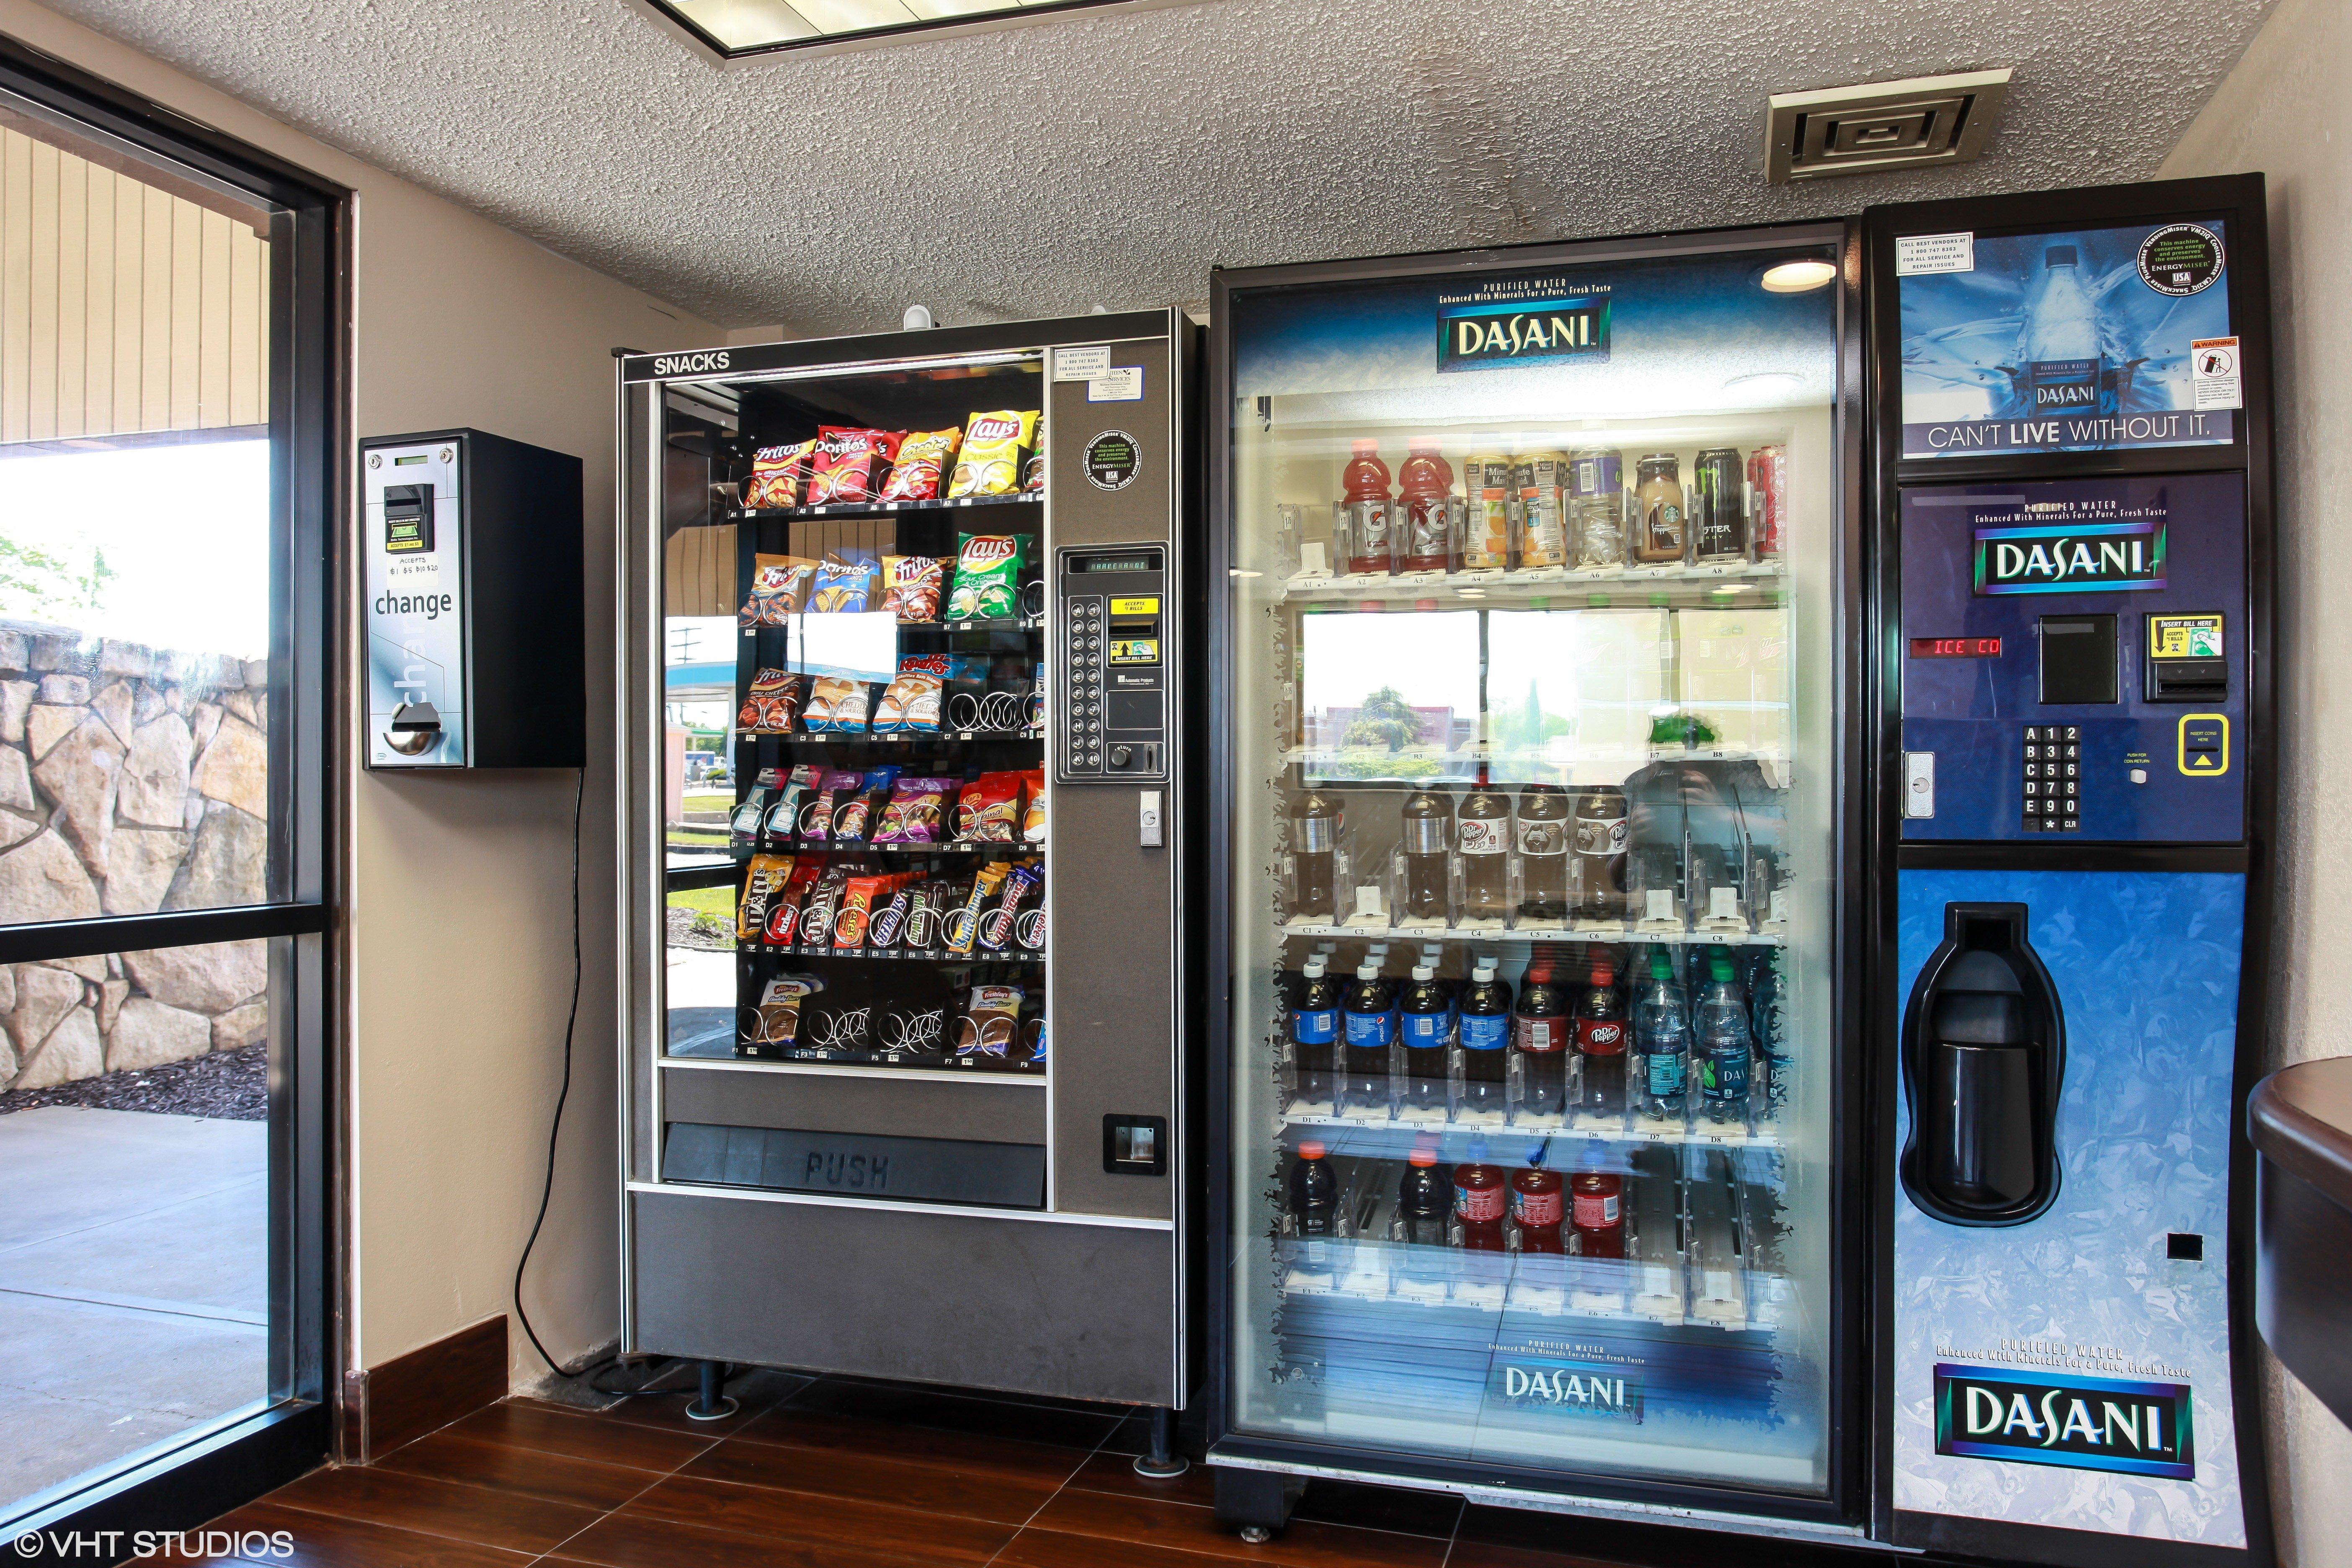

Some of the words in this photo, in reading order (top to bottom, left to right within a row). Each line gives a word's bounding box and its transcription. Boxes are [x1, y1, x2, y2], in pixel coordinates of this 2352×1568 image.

[2173, 273, 2190, 282] USA
[1484, 281, 1528, 292] PURIFIED
[1535, 279, 1566, 289] WATER
[1494, 291, 1524, 299] Minerals
[1570, 285, 1589, 294] Fresh
[1459, 314, 1589, 356] DASANI
[655, 352, 730, 375] SNACKS
[2037, 386, 2094, 405] DASANI
[967, 420, 1018, 441] Lay's
[1928, 425, 2001, 448] CAN'T
[2011, 422, 2059, 444] LIVE
[2068, 416, 2179, 441] WITHOUT
[2190, 415, 2210, 436] IT.
[756, 444, 802, 461] Fritos
[815, 438, 867, 453] Doritos
[965, 452, 1002, 461] Classic
[2025, 502, 2073, 512] PURIFIED
[2082, 501, 2116, 510] WATER
[1975, 514, 2011, 523] Enhanced
[2014, 513, 2032, 521] With
[2036, 512, 2069, 520] Minerals
[2073, 510, 2085, 519] For
[2120, 509, 2141, 517] Fresh
[2146, 508, 2167, 516] Taste
[961, 539, 1013, 562] Lay's
[1997, 538, 2143, 581] DASANI
[376, 589, 451, 619] change
[1935, 641, 1964, 654] ICE
[1978, 640, 1999, 653] CO
[2027, 728, 2035, 739] A
[2048, 728, 2053, 739] 1
[2068, 728, 2075, 739] 2
[2027, 746, 2035, 757] B
[2048, 746, 2055, 757] 3
[2068, 746, 2075, 757] 4
[2027, 764, 2035, 776] C
[2048, 764, 2054, 775] 5
[2068, 764, 2075, 775] 6
[2027, 782, 2035, 793] D
[2048, 782, 2054, 793] 7
[2067, 782, 2074, 794] 8
[2027, 801, 2034, 811] E
[2047, 800, 2054, 812] 9
[1464, 826, 1483, 838] Pepper
[1591, 1029, 1617, 1042] Pepper
[806, 1152, 889, 1189] PUSH
[1488, 1343, 1518, 1352] Enhanced
[1538, 1347, 1565, 1356] Minerals
[1529, 1340, 1570, 1350] PURIFIED
[1576, 1344, 1604, 1353] WATER
[2001, 1338, 2068, 1355] PURIFIED
[2076, 1345, 2123, 1361] WATER
[1937, 1345, 1983, 1359] Enhanced
[1988, 1349, 2012, 1362] With
[2017, 1352, 2061, 1367] Minerals
[2066, 1357, 2082, 1369] For
[2096, 1359, 2123, 1373] Pure,
[2128, 1362, 2157, 1375] Fresh
[2162, 1364, 2191, 1377] Taste
[1506, 1367, 1625, 1406] DASANI
[1966, 1386, 2161, 1452] DASANI
